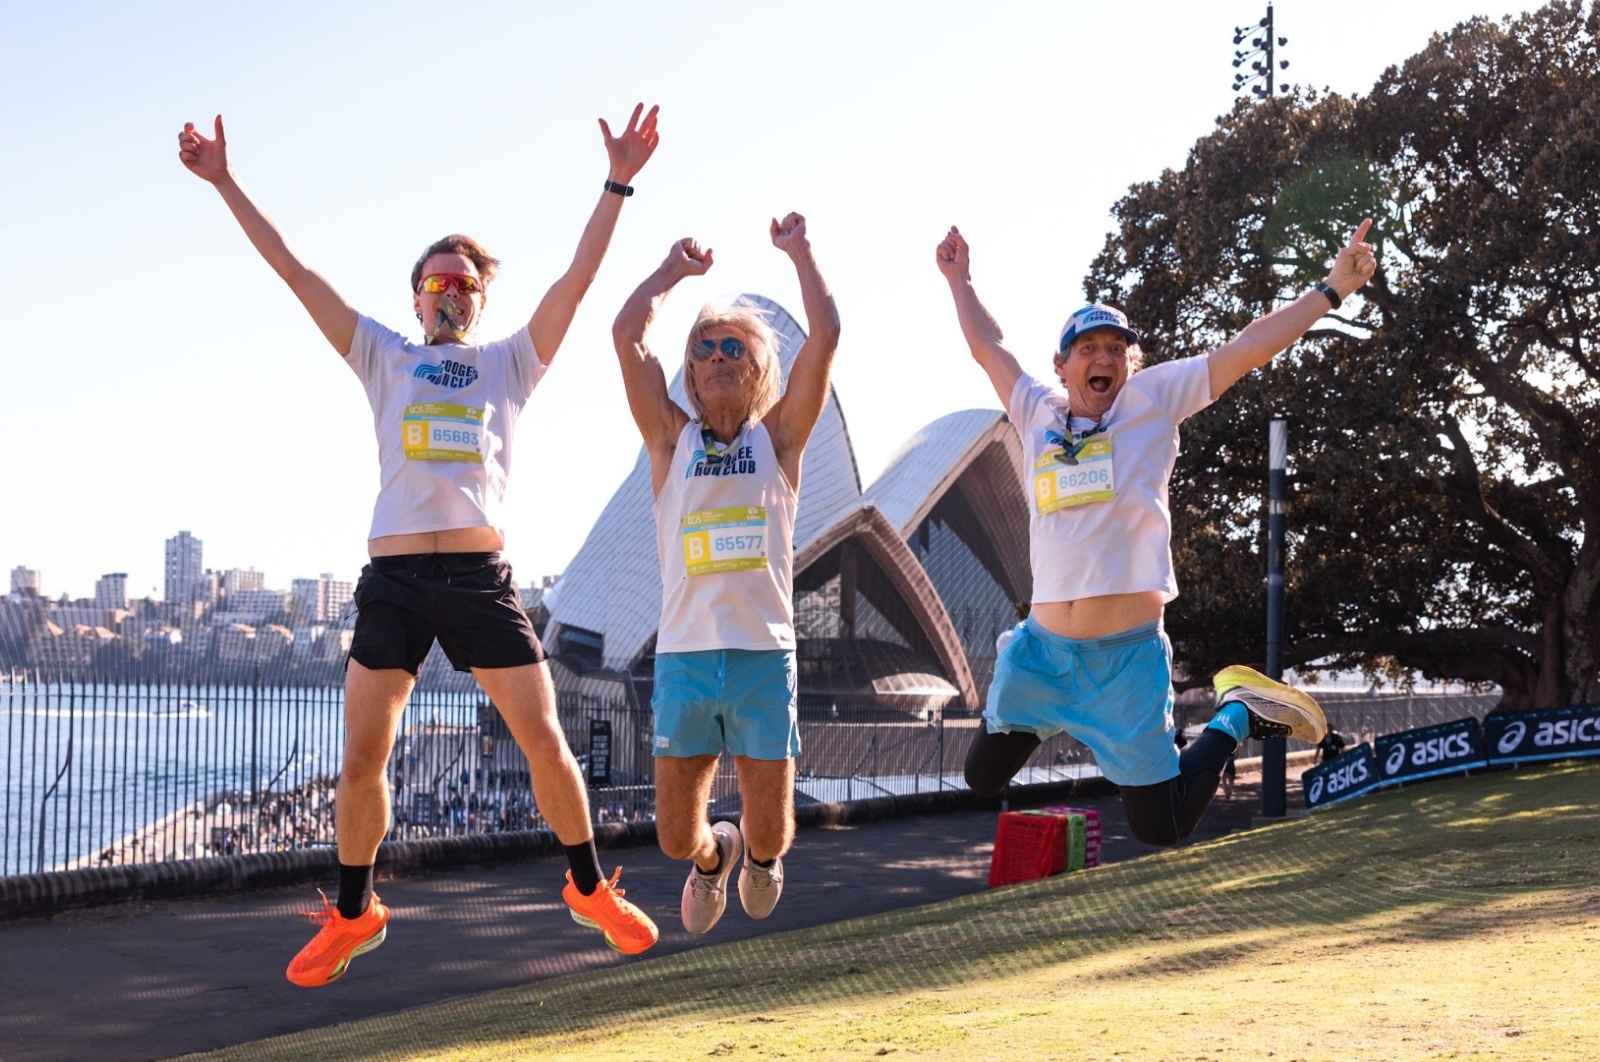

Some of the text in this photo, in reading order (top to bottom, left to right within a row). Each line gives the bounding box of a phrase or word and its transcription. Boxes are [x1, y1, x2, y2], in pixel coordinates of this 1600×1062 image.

[433, 429, 479, 445] 65683
[722, 460, 756, 475] CLUB
[1060, 469, 1108, 489] 66206
[689, 535, 762, 560] B 65577
[1412, 731, 1470, 765] asics
[1327, 758, 1368, 794] asics
